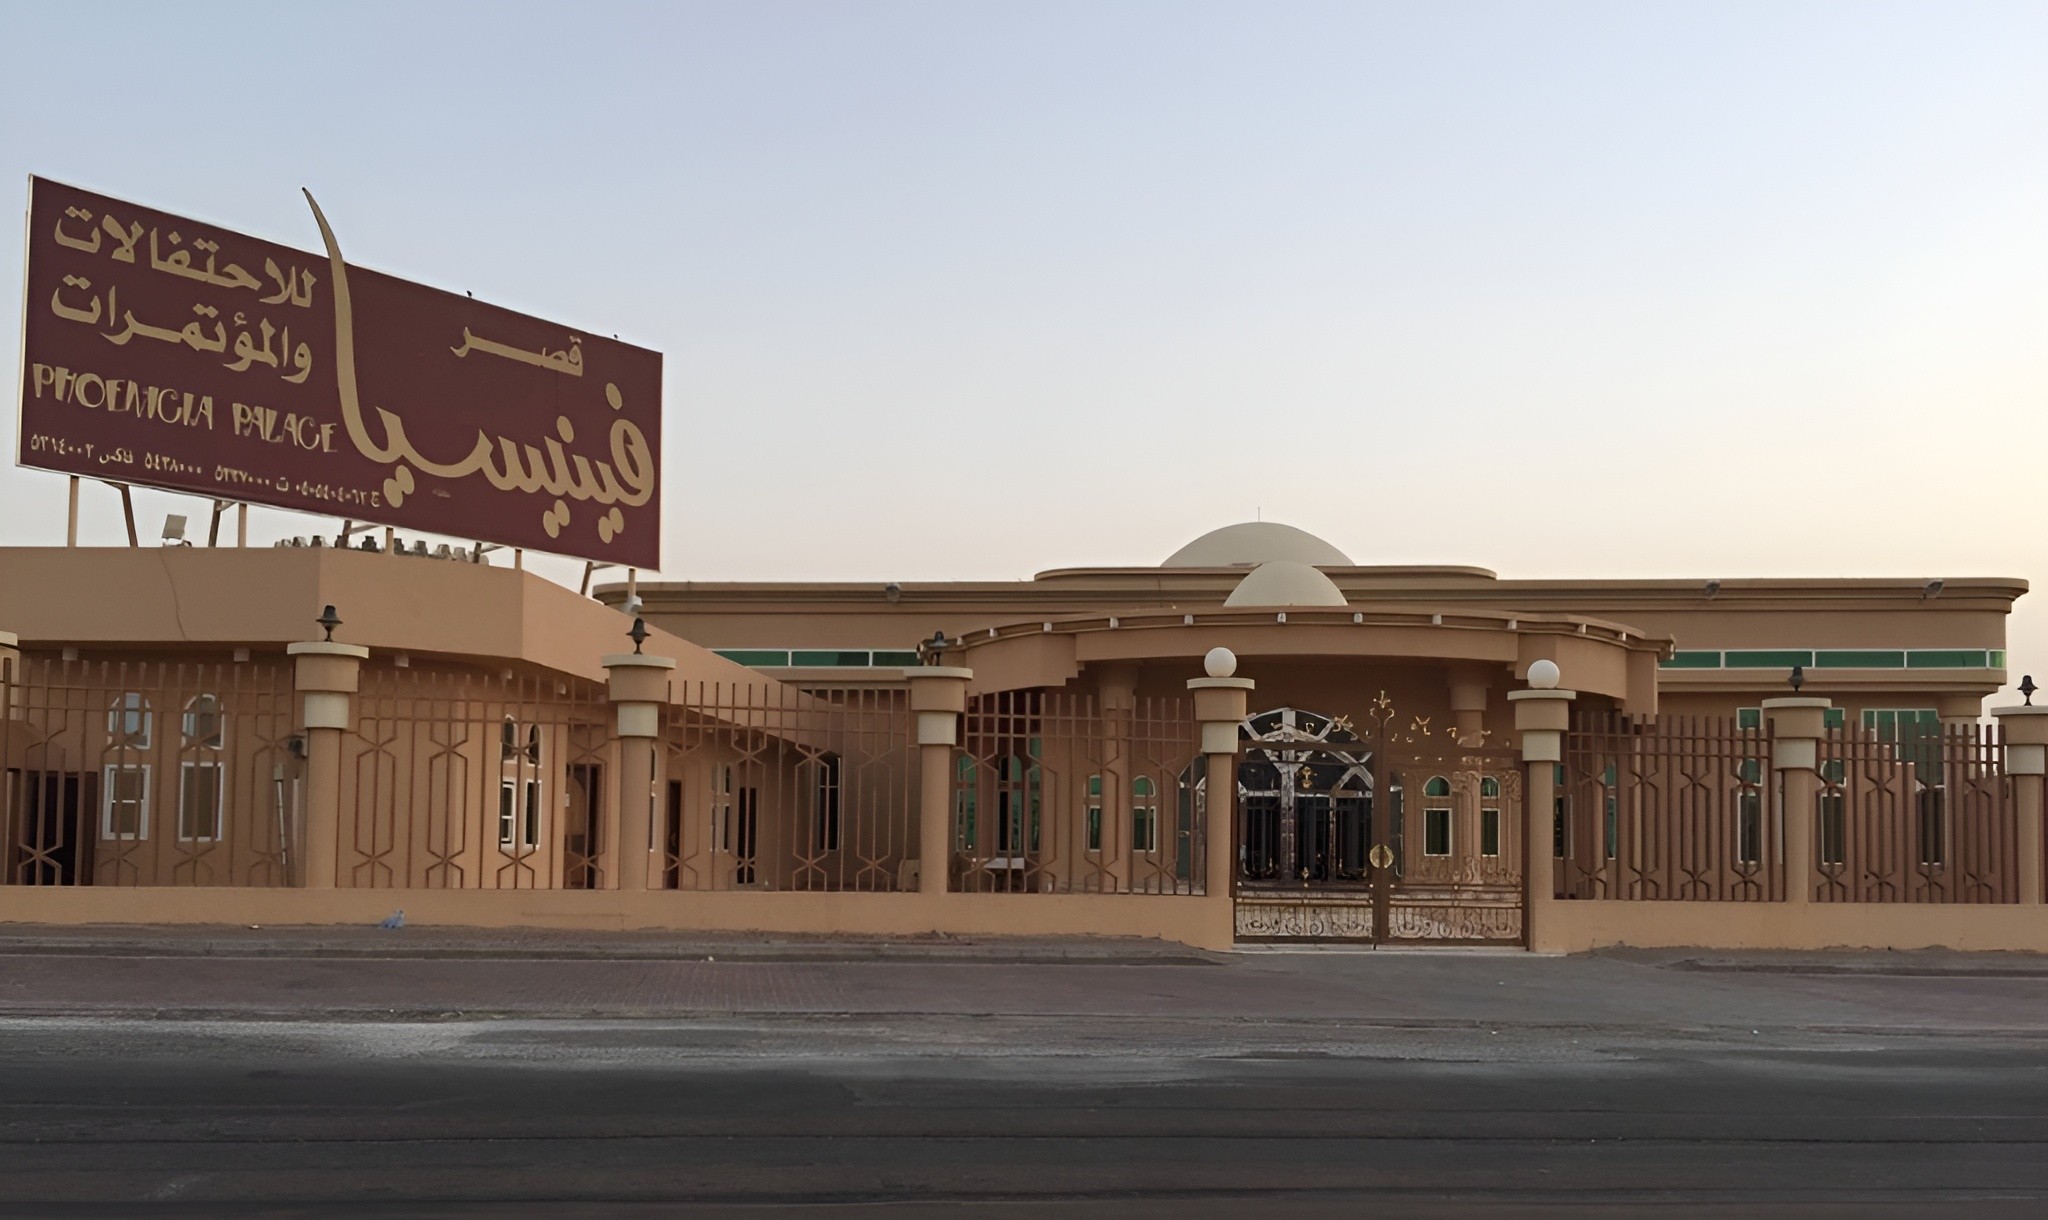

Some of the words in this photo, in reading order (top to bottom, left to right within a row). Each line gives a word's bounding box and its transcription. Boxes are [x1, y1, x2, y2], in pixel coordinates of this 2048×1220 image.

[54, 205, 317, 308] للاحتفالات
[51, 274, 312, 384] والمؤتمرات
[302, 187, 655, 544] فينيسيا
[450, 326, 584, 377] قصر
[32, 363, 213, 431] PHOENICIA
[232, 402, 338, 453] PALACE
